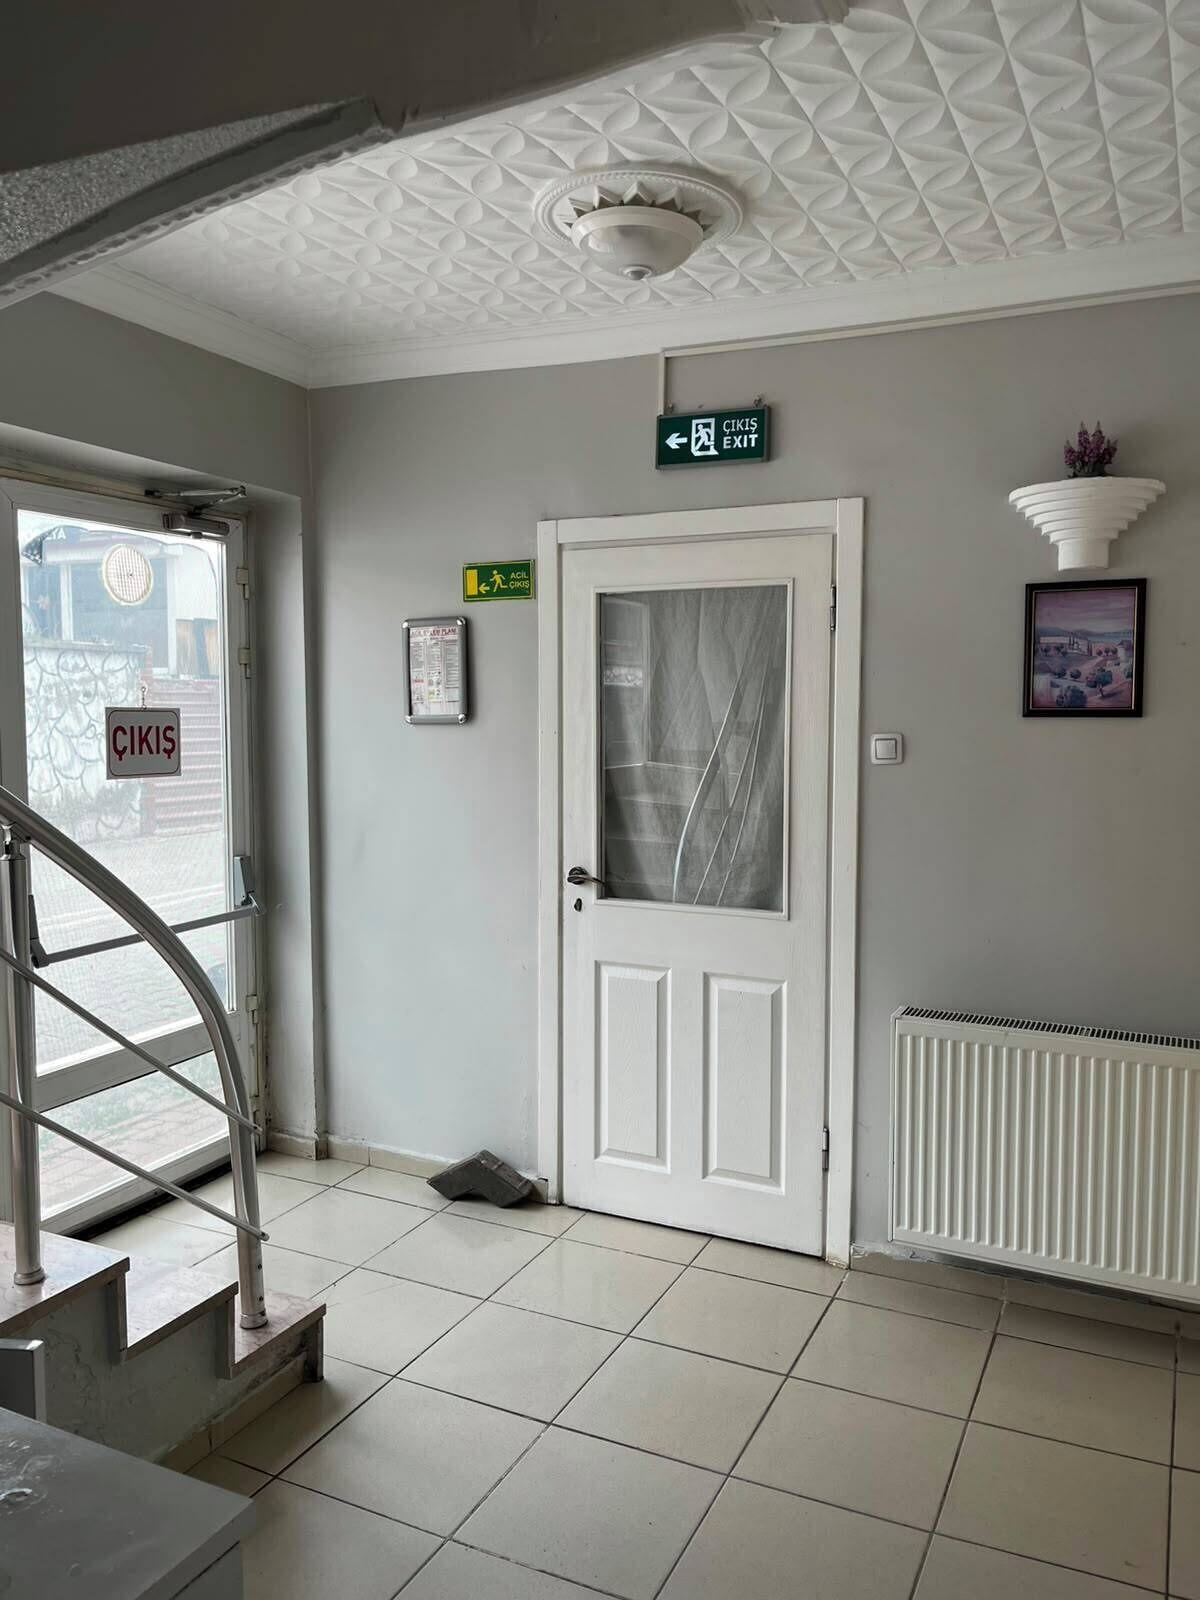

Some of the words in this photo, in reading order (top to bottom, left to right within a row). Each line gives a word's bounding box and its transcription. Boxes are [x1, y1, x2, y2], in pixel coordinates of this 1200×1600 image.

[723, 418, 758, 434] ÇIKIŞ
[723, 434, 758, 449] EXIT
[112, 725, 176, 761] ÇIKIŞ
